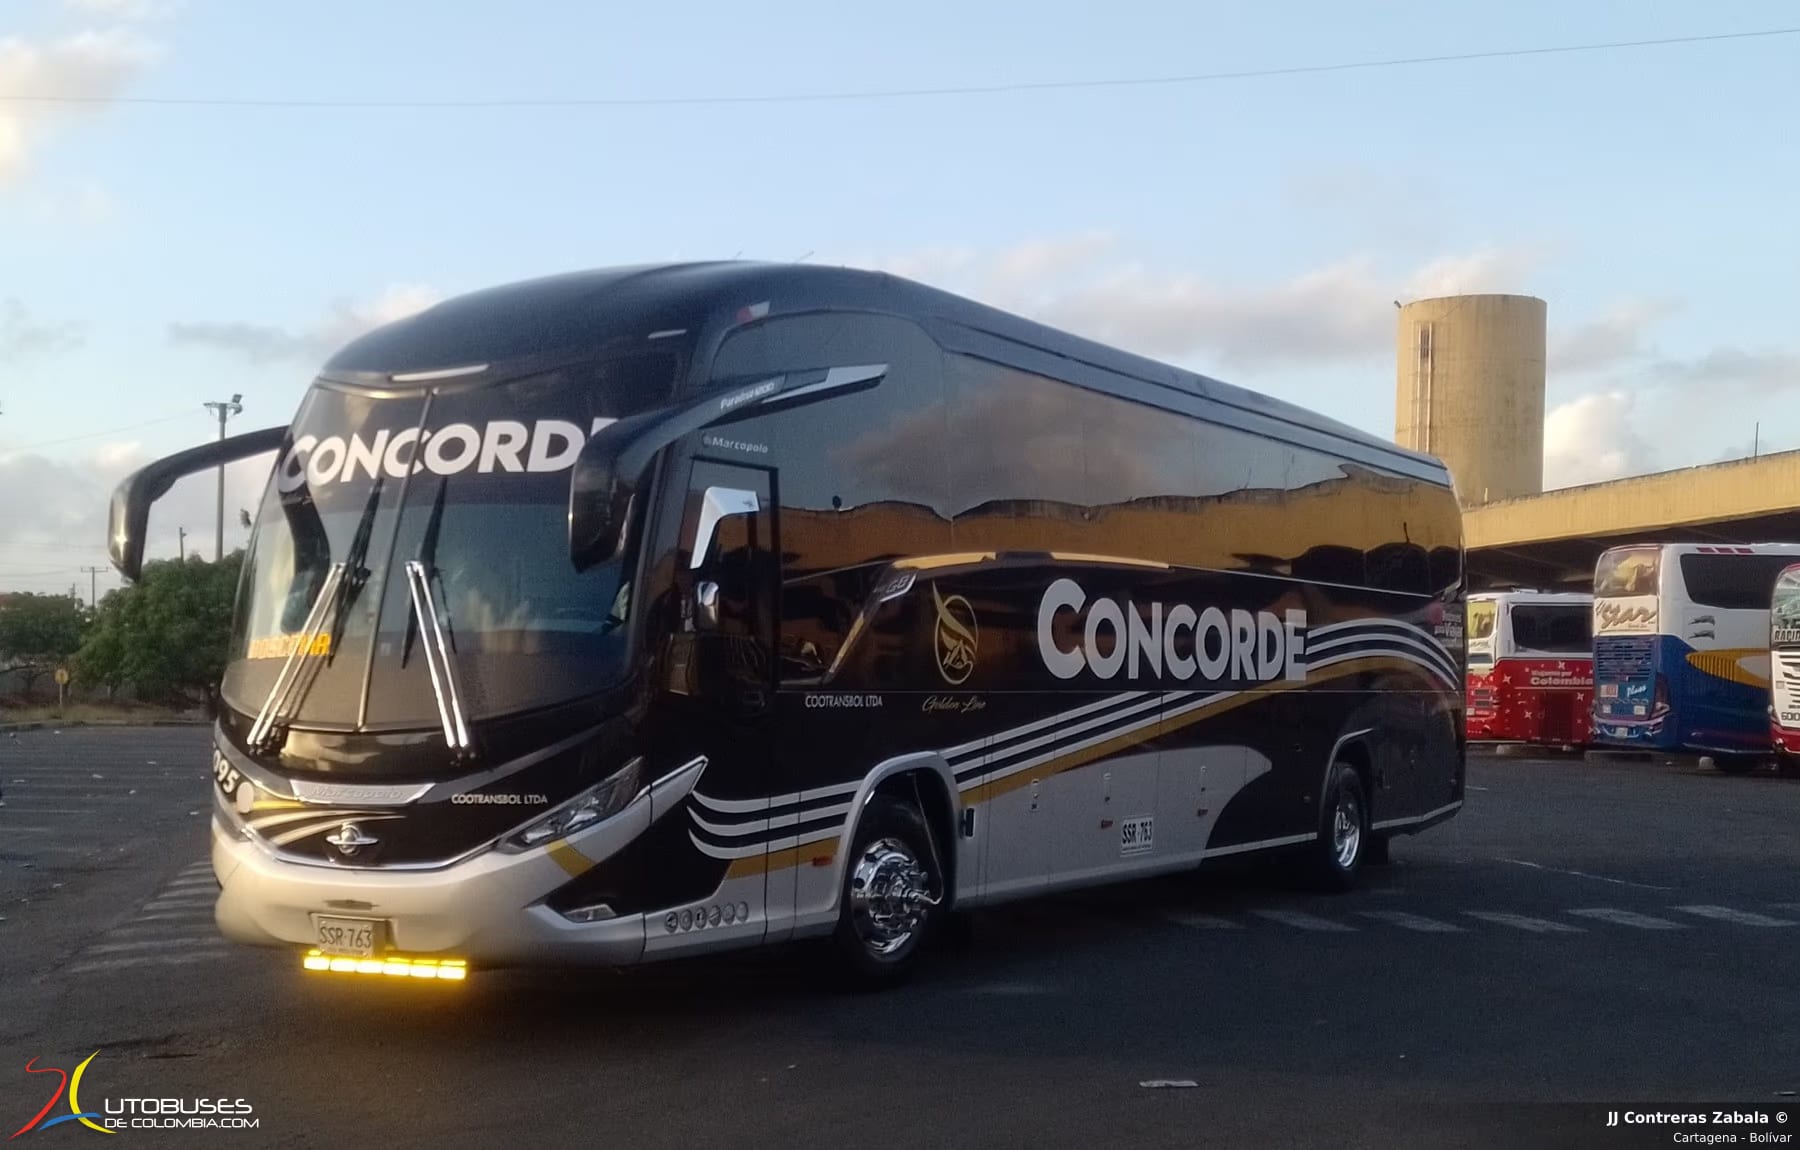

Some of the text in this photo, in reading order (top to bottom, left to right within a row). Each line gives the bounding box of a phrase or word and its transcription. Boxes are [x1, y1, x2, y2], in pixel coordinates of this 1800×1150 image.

[712, 436, 768, 454] Marcopolo
[278, 417, 618, 493] CONCORD
[1037, 578, 1307, 681] CONCORDE
[805, 695, 883, 708] COOTRANSBOL LTDA
[921, 695, 960, 712] Golden
[451, 793, 548, 805] COOTRANSBOL LTDA
